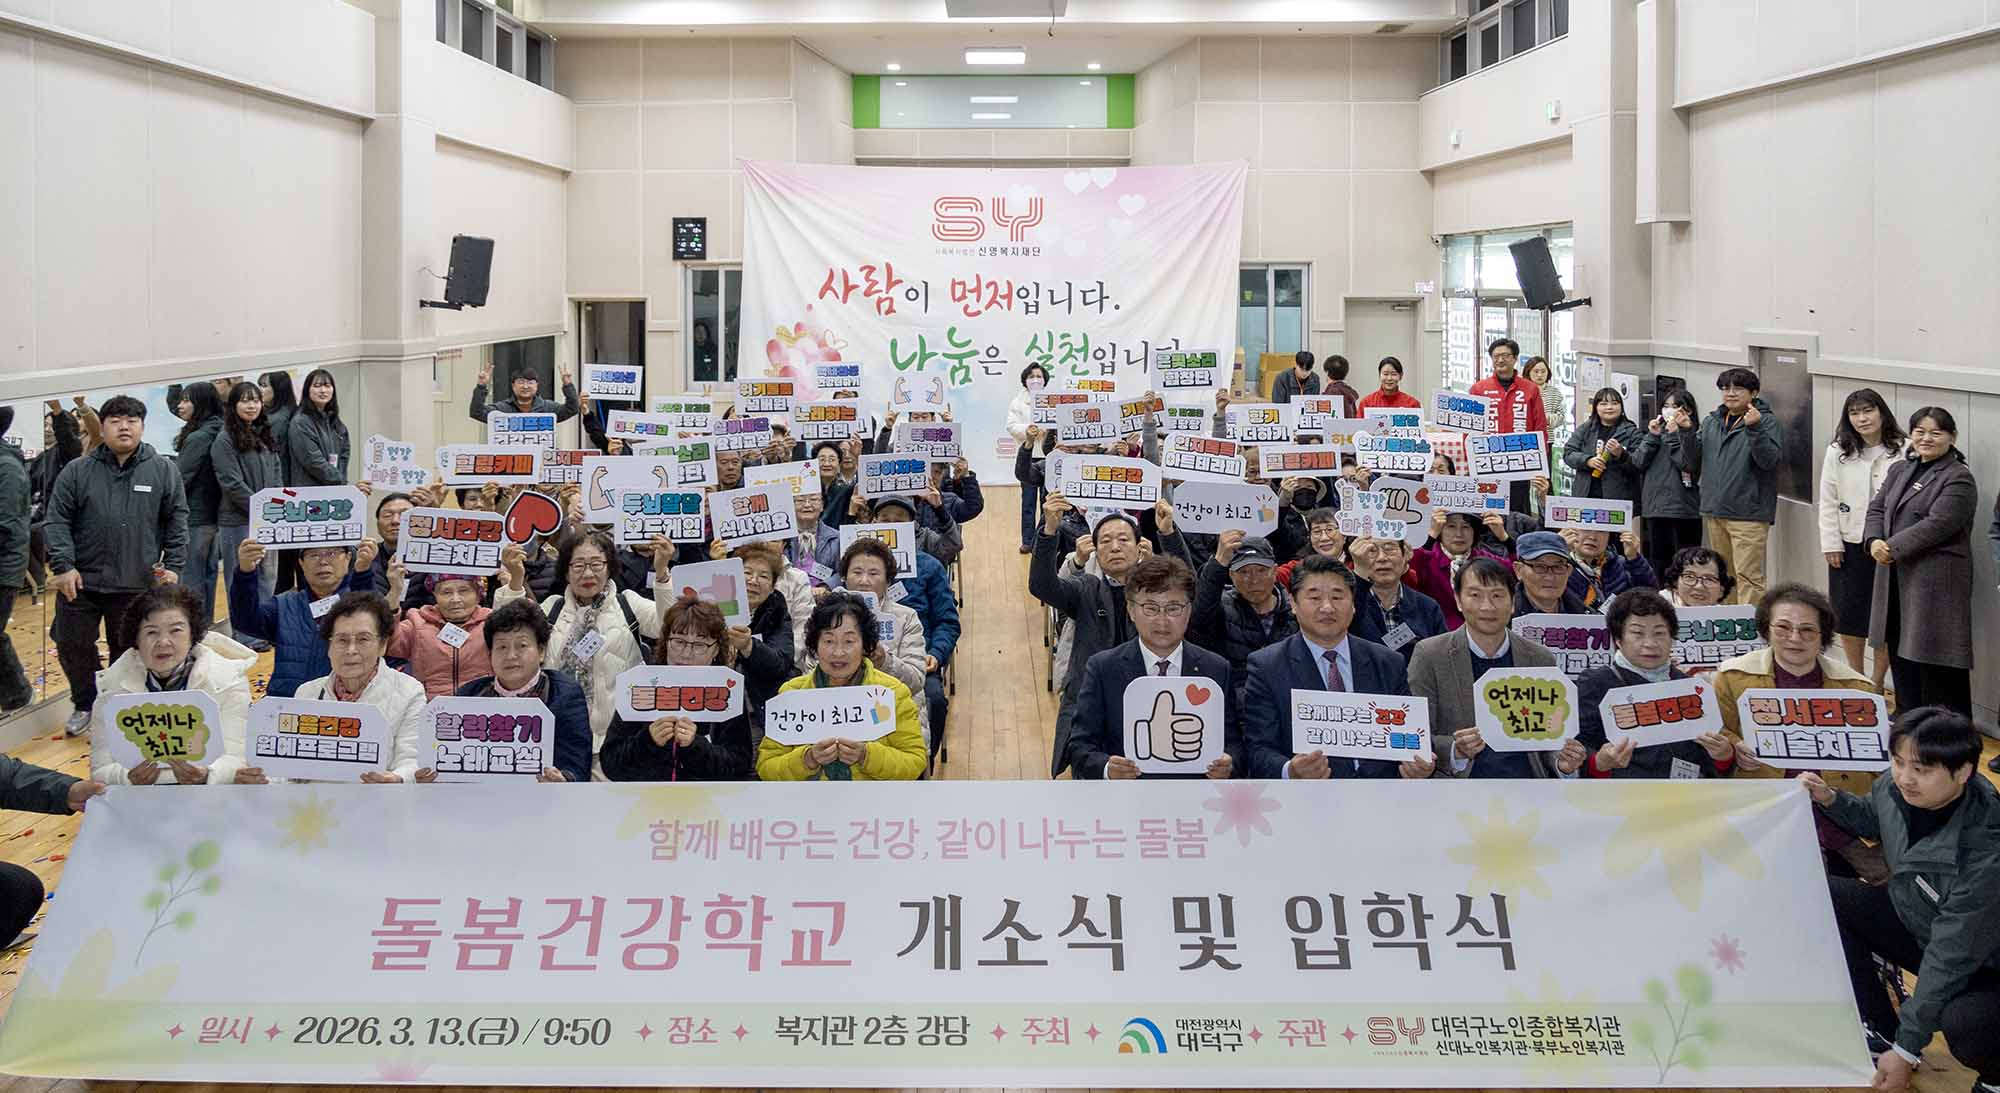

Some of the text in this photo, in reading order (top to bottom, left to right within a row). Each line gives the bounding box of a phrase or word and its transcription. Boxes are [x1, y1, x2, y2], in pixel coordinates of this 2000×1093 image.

[932, 196, 1043, 242] SY
[979, 246, 1041, 257] 신영복지재단
[818, 261, 1121, 317] 사람이 먼저입니다.
[889, 325, 1008, 389] 나눔은
[1162, 369, 1213, 388] 합창단
[1514, 390, 1525, 402] 2
[795, 404, 857, 422] 노래하는
[1072, 408, 1102, 424] 함께
[1248, 408, 1280, 424] 향기
[715, 432, 771, 451] 요리교실
[1062, 423, 1117, 441] 식사해요
[1241, 425, 1290, 442] 더하기
[387, 446, 412, 463] 건강
[1165, 451, 1242, 477] 아트테라피
[1475, 452, 1543, 475] 건강교실
[371, 466, 426, 485] 마음 건강
[1065, 481, 1158, 503] 원예프로그램
[1358, 492, 1387, 511] 건강
[262, 499, 354, 523] 두뇌건강
[731, 493, 770, 517] 함께
[1175, 502, 1253, 522] 건강이 최고
[256, 522, 363, 544] 공예프로그램
[408, 514, 504, 543] 정서건강
[623, 517, 703, 541] 보드게임
[719, 511, 792, 541] 식사해요
[1342, 514, 1405, 538] 마음 건강
[403, 540, 501, 569] 미술치료
[1678, 617, 1758, 642] 두뇌건강
[630, 685, 731, 712] 돌봄건강
[1488, 684, 1559, 708] 언제나
[122, 712, 197, 735] 언제나
[770, 705, 864, 733] 건강이 최고
[1375, 708, 1406, 726] 건강
[1506, 711, 1549, 734] 최고
[1611, 693, 1704, 731] 돌봄건강
[1749, 697, 1879, 728] 정서건강
[436, 712, 543, 743] 활력찾기
[1306, 726, 1421, 751] 같이 나누는 돌봄
[145, 737, 187, 758] 최고
[255, 734, 380, 765] 원예프로그램
[1755, 729, 1889, 762] 미술치료
[436, 744, 543, 775] 노래교실
[649, 817, 1209, 862] 함께 배우는 건강, 같이 나누는 돌봄
[370, 891, 1517, 973] 돌봄건강학교 개소식 및 입학식
[198, 1016, 254, 1045] 일시
[293, 1016, 382, 1046] 2026.
[389, 1016, 415, 1046] 3.
[543, 1016, 612, 1046] 9:50
[667, 1016, 970, 1046] 장소 복지관 2층 강당
[1022, 1017, 1072, 1046] 주최
[1175, 1018, 1243, 1032] 대전광역시
[1277, 1019, 1328, 1048] 주관
[1366, 1016, 1426, 1046] SY
[1431, 1016, 1622, 1039] 대덕구노인종합복지관
[1177, 1032, 1244, 1052] 대덕구
[1436, 1040, 1626, 1057] 신대노인복지관·북부노인복지관
